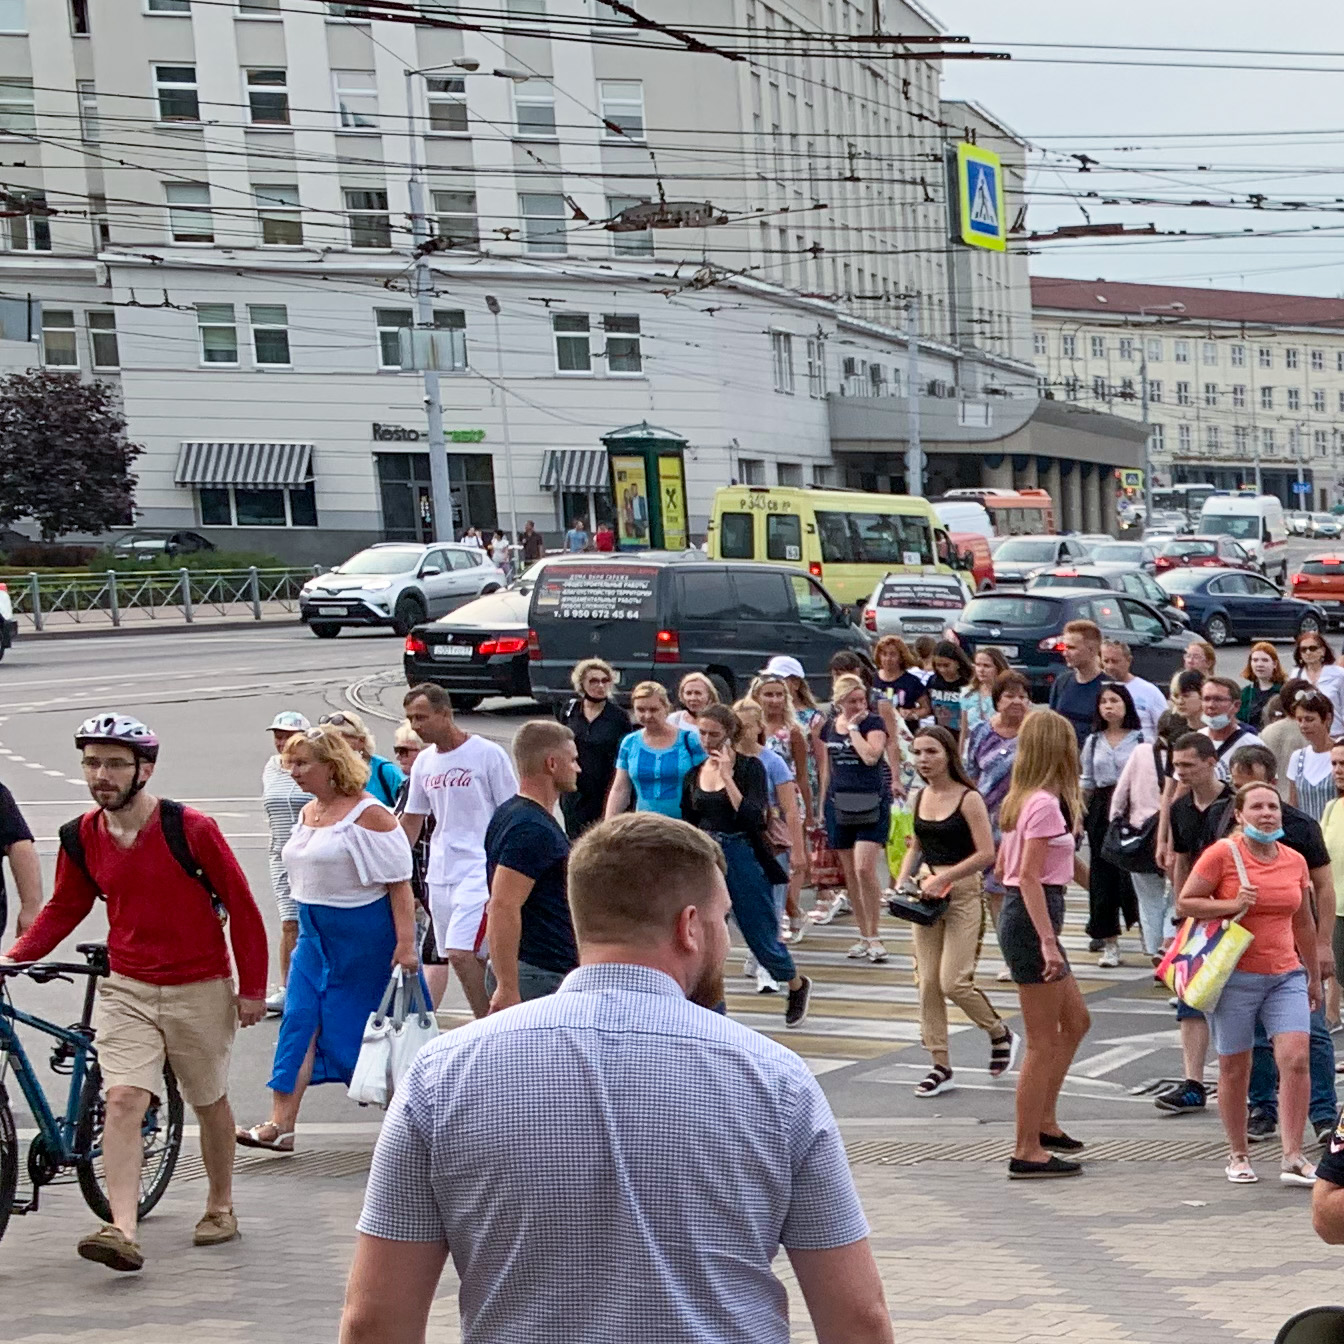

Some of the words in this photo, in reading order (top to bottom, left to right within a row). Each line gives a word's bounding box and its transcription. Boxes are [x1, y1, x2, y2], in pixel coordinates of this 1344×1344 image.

[563, 610, 570, 618] 8
[572, 610, 590, 618] 950
[591, 610, 610, 619] 672
[626, 610, 639, 619] 64
